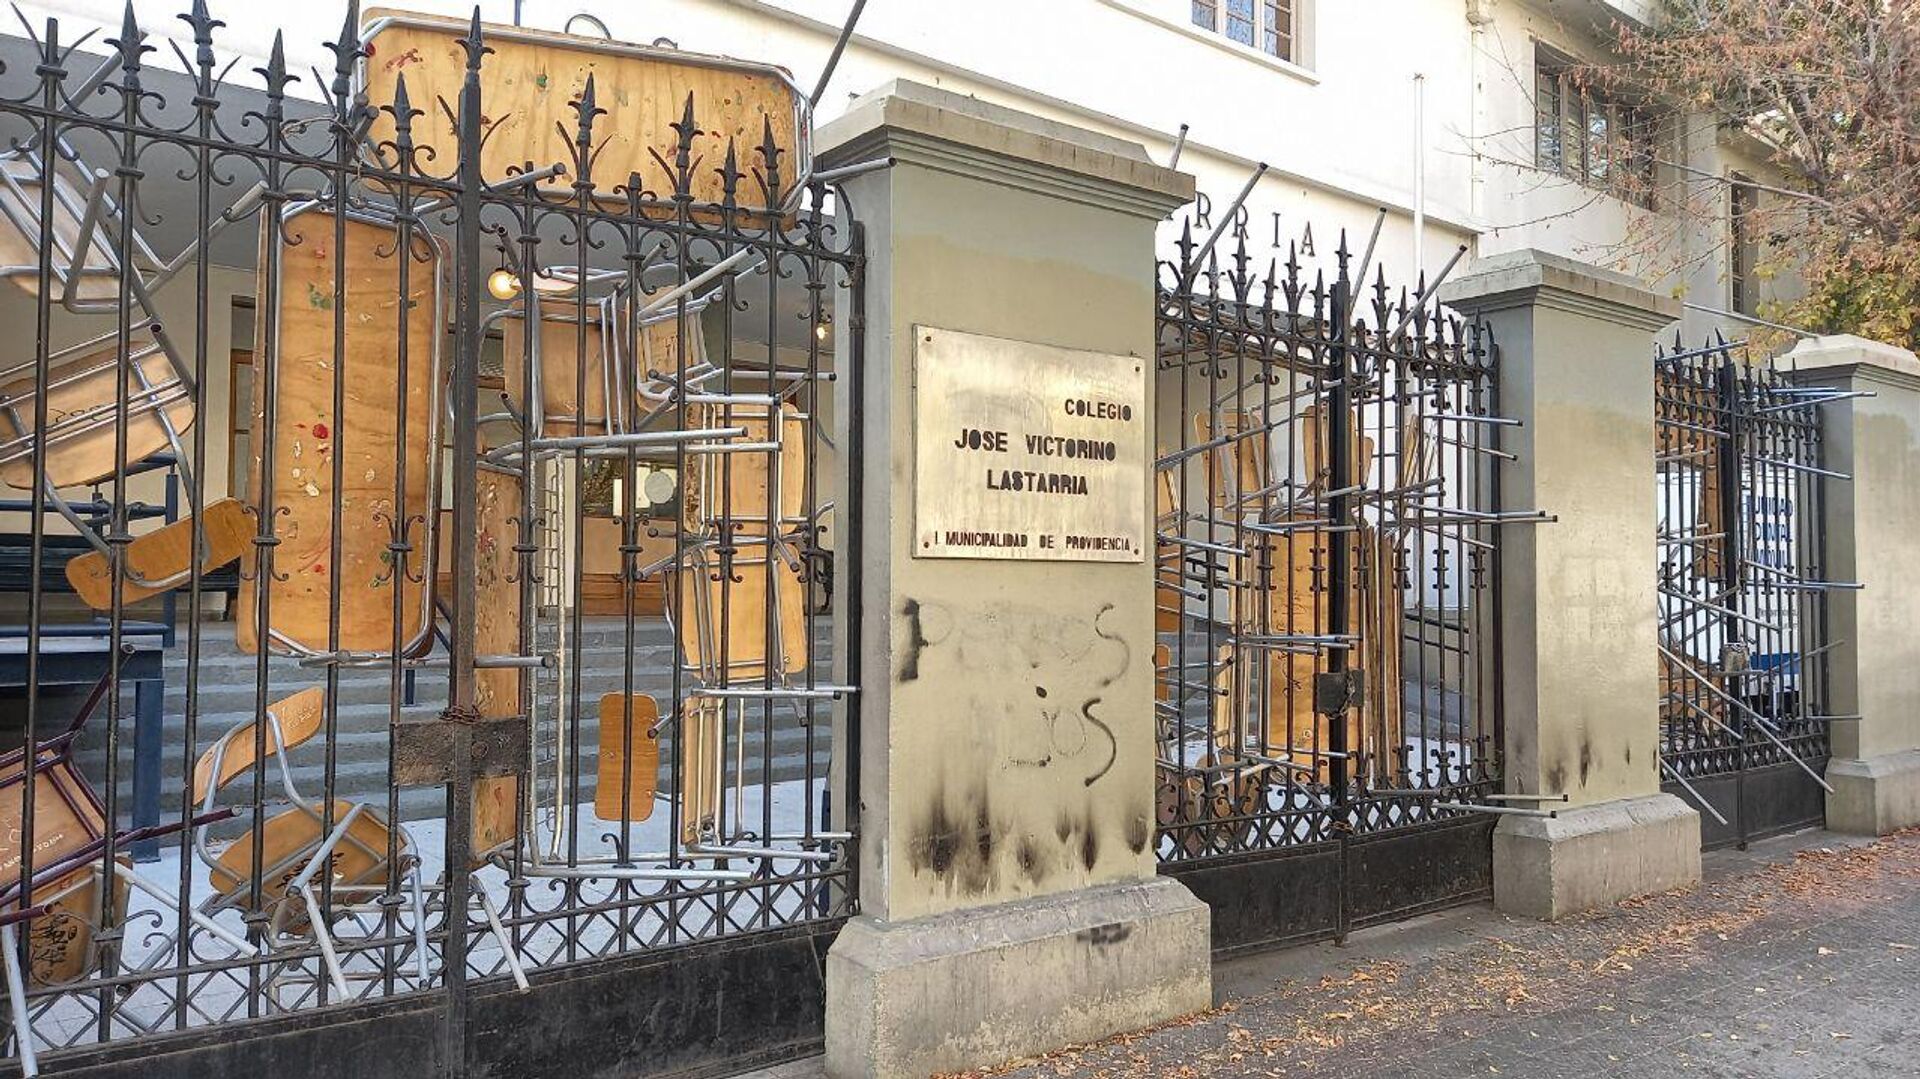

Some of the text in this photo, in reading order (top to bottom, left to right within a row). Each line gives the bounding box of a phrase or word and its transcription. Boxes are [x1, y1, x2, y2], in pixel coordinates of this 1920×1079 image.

[1164, 191, 1315, 256] RRIA
[1065, 398, 1132, 421] COLEGIO
[954, 428, 1116, 461] JOSE VICTORINO
[987, 469, 1088, 495] LASTARRIA
[945, 531, 1028, 547] MUNICIPALIDAD
[1040, 535, 1054, 549] DE
[1065, 535, 1130, 551] PROVIDENCIA
